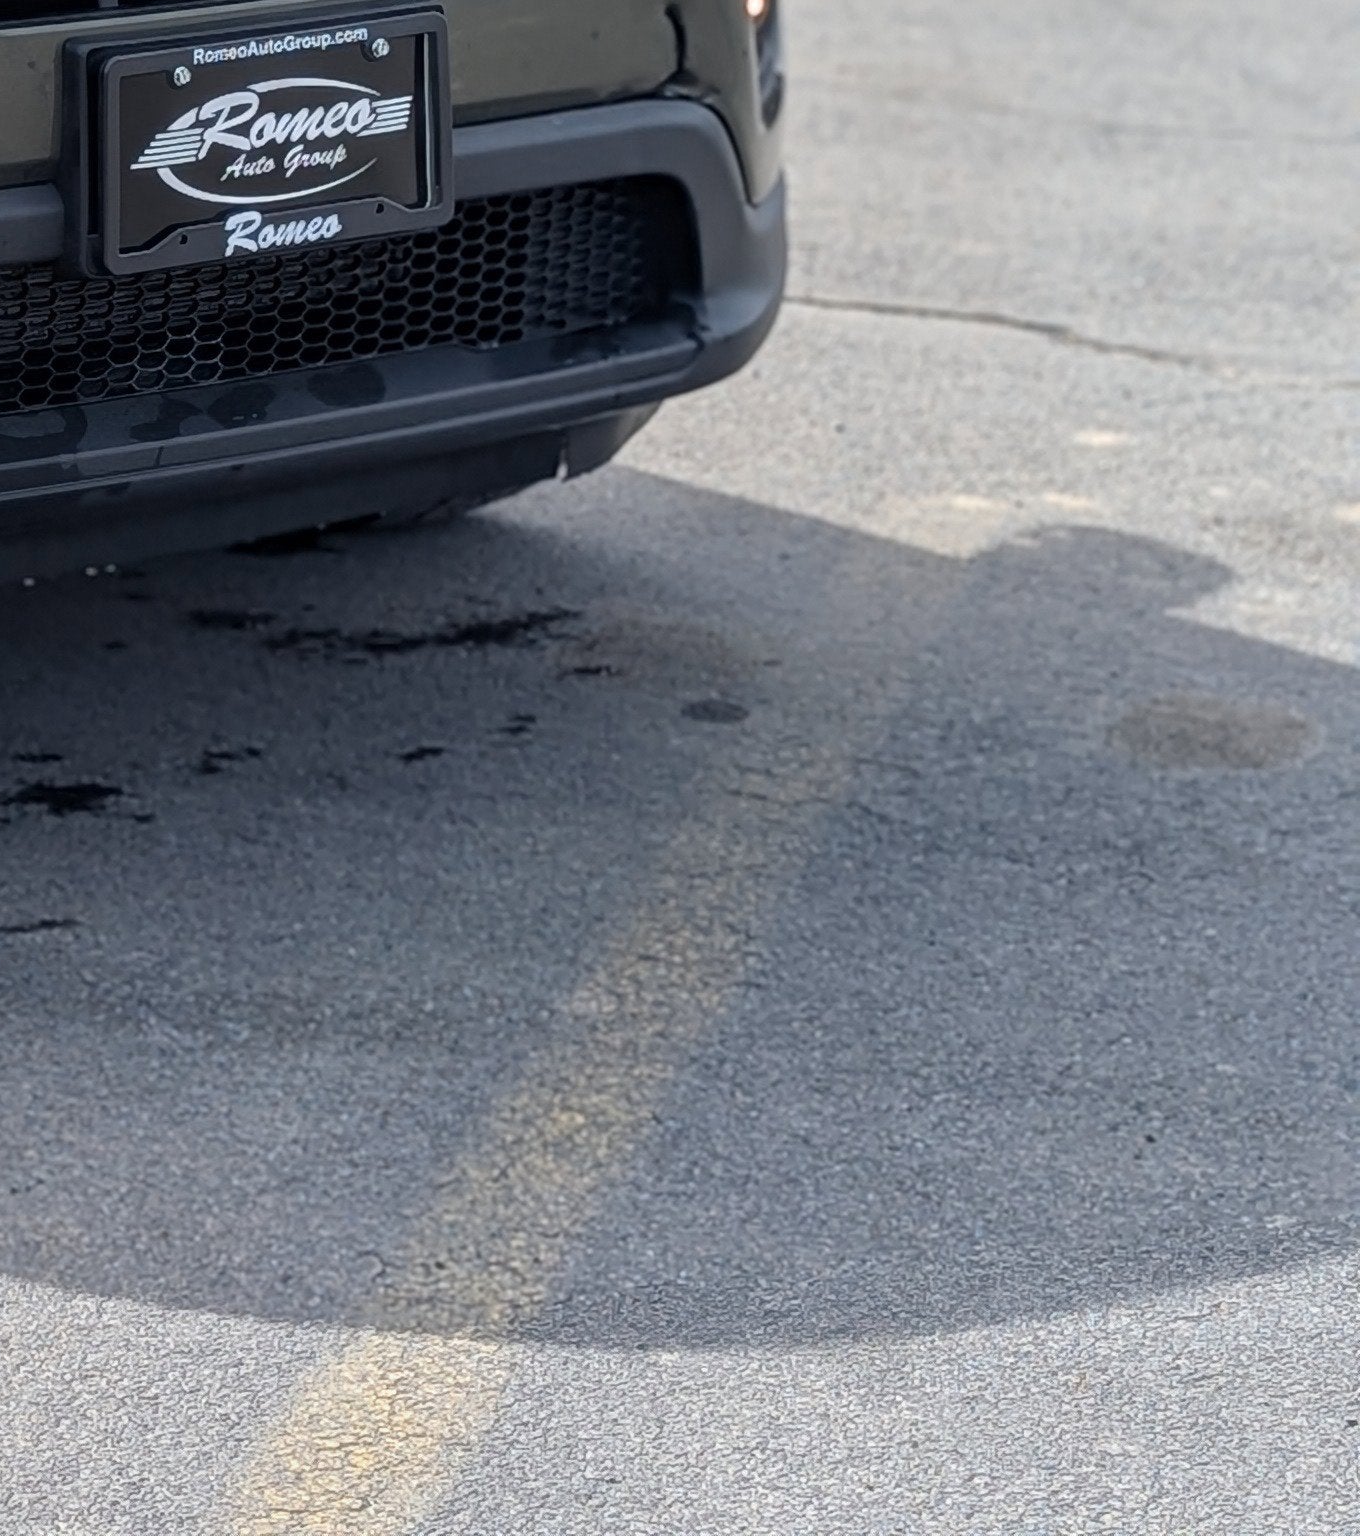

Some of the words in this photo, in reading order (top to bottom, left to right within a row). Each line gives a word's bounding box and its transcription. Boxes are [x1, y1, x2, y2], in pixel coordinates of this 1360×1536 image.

[192, 27, 369, 66] RomeoAutoGroup.com
[196, 90, 378, 161] Romeo
[219, 152, 277, 182] Auto
[282, 142, 348, 178] Group
[223, 210, 343, 258] Romeo
